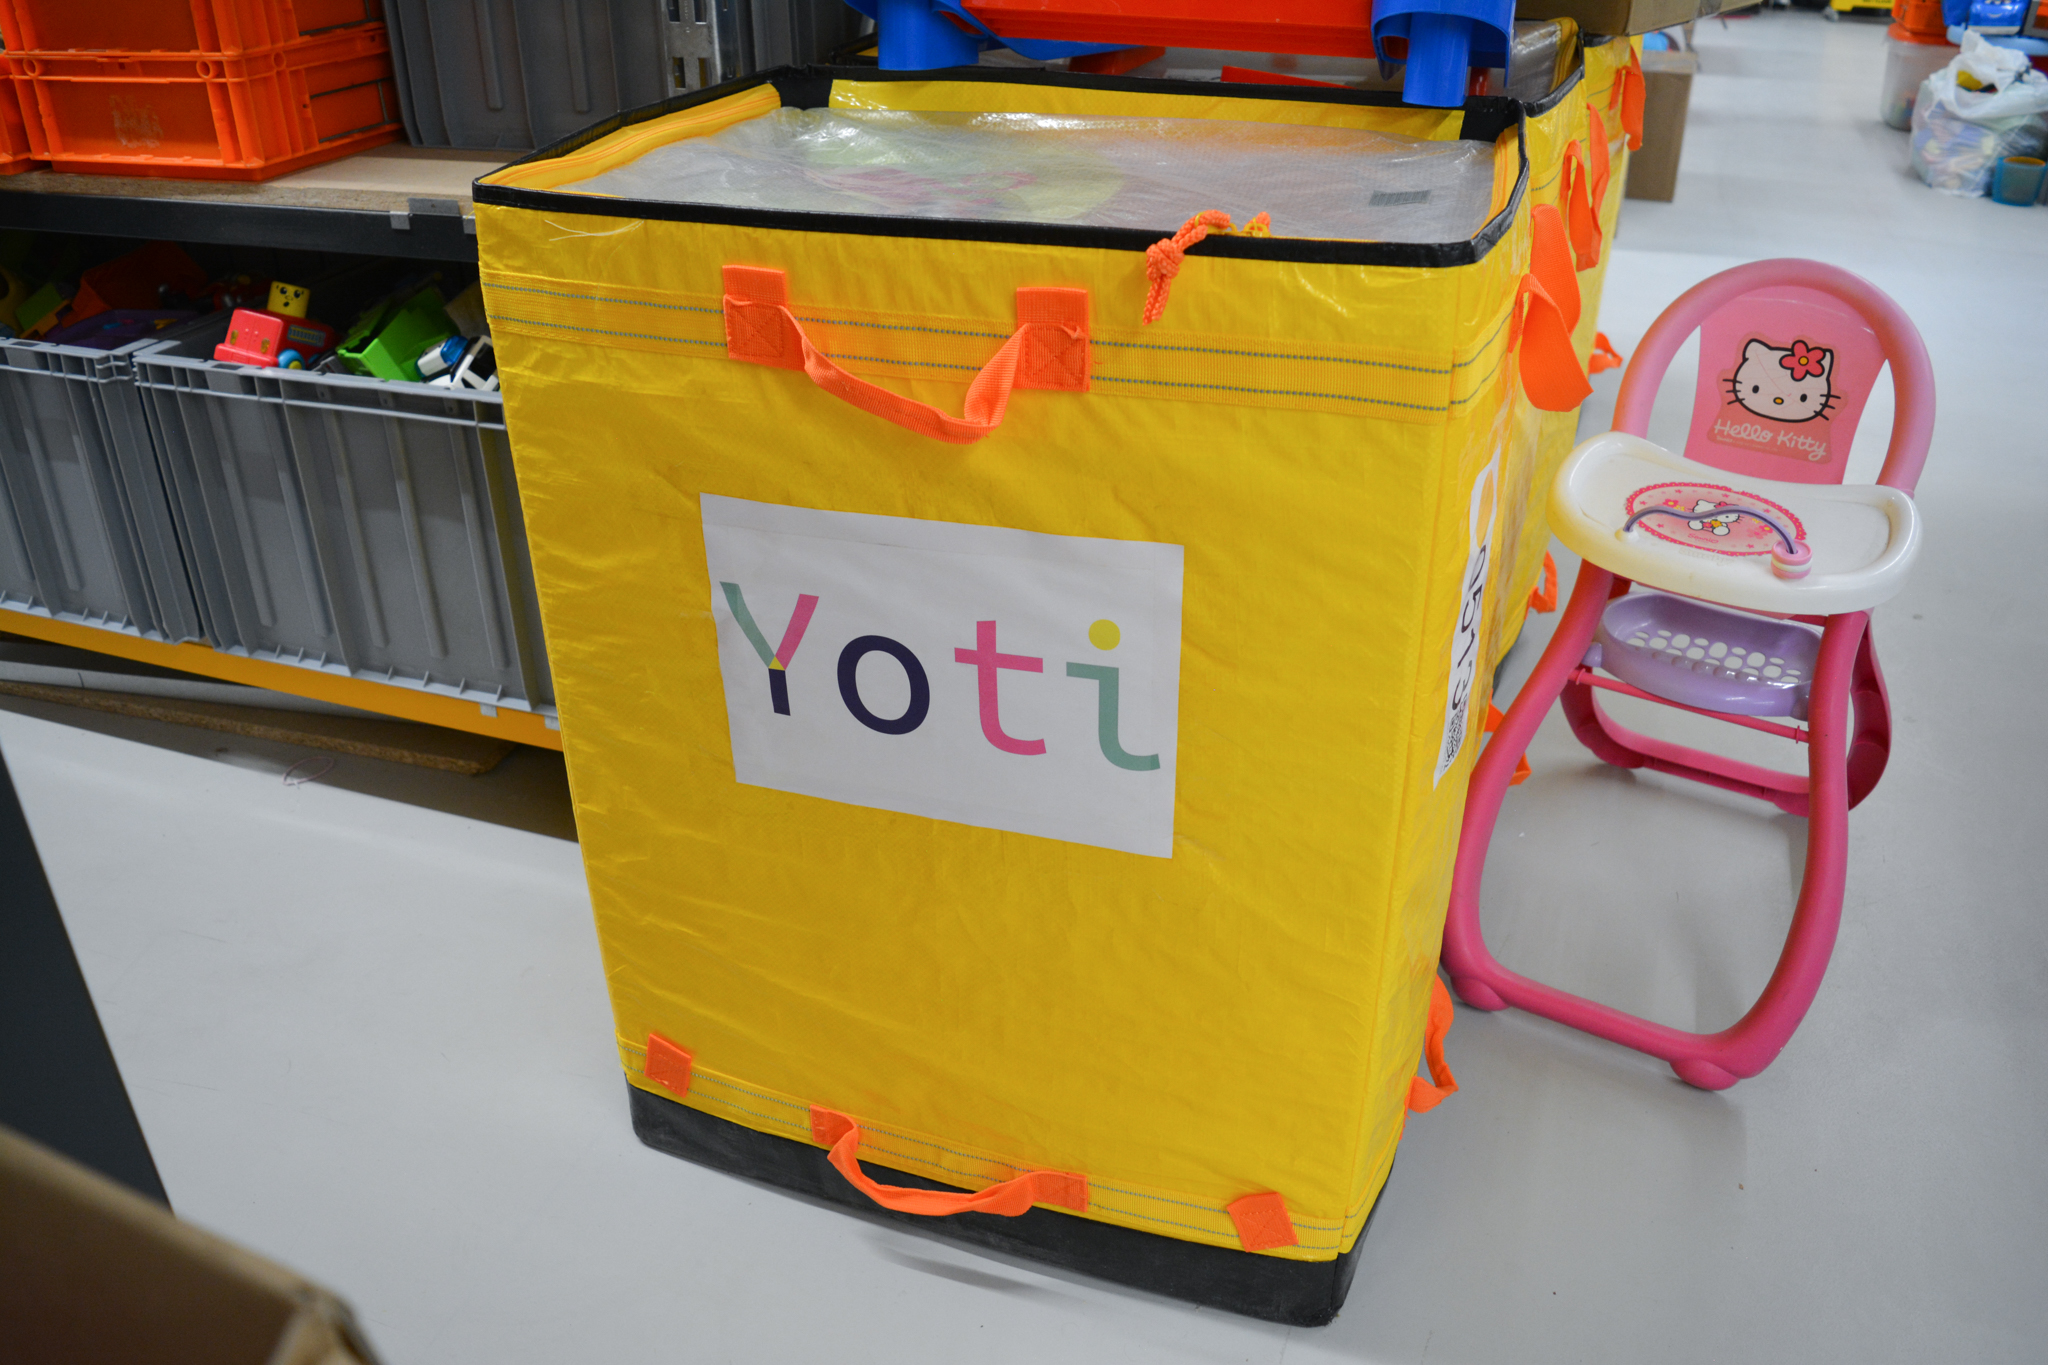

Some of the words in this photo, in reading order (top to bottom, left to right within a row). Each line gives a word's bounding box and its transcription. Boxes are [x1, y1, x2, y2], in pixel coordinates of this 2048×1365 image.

[1714, 419, 1773, 442] Hello
[1777, 430, 1826, 461] Kitty
[719, 581, 1160, 772] Yoti
